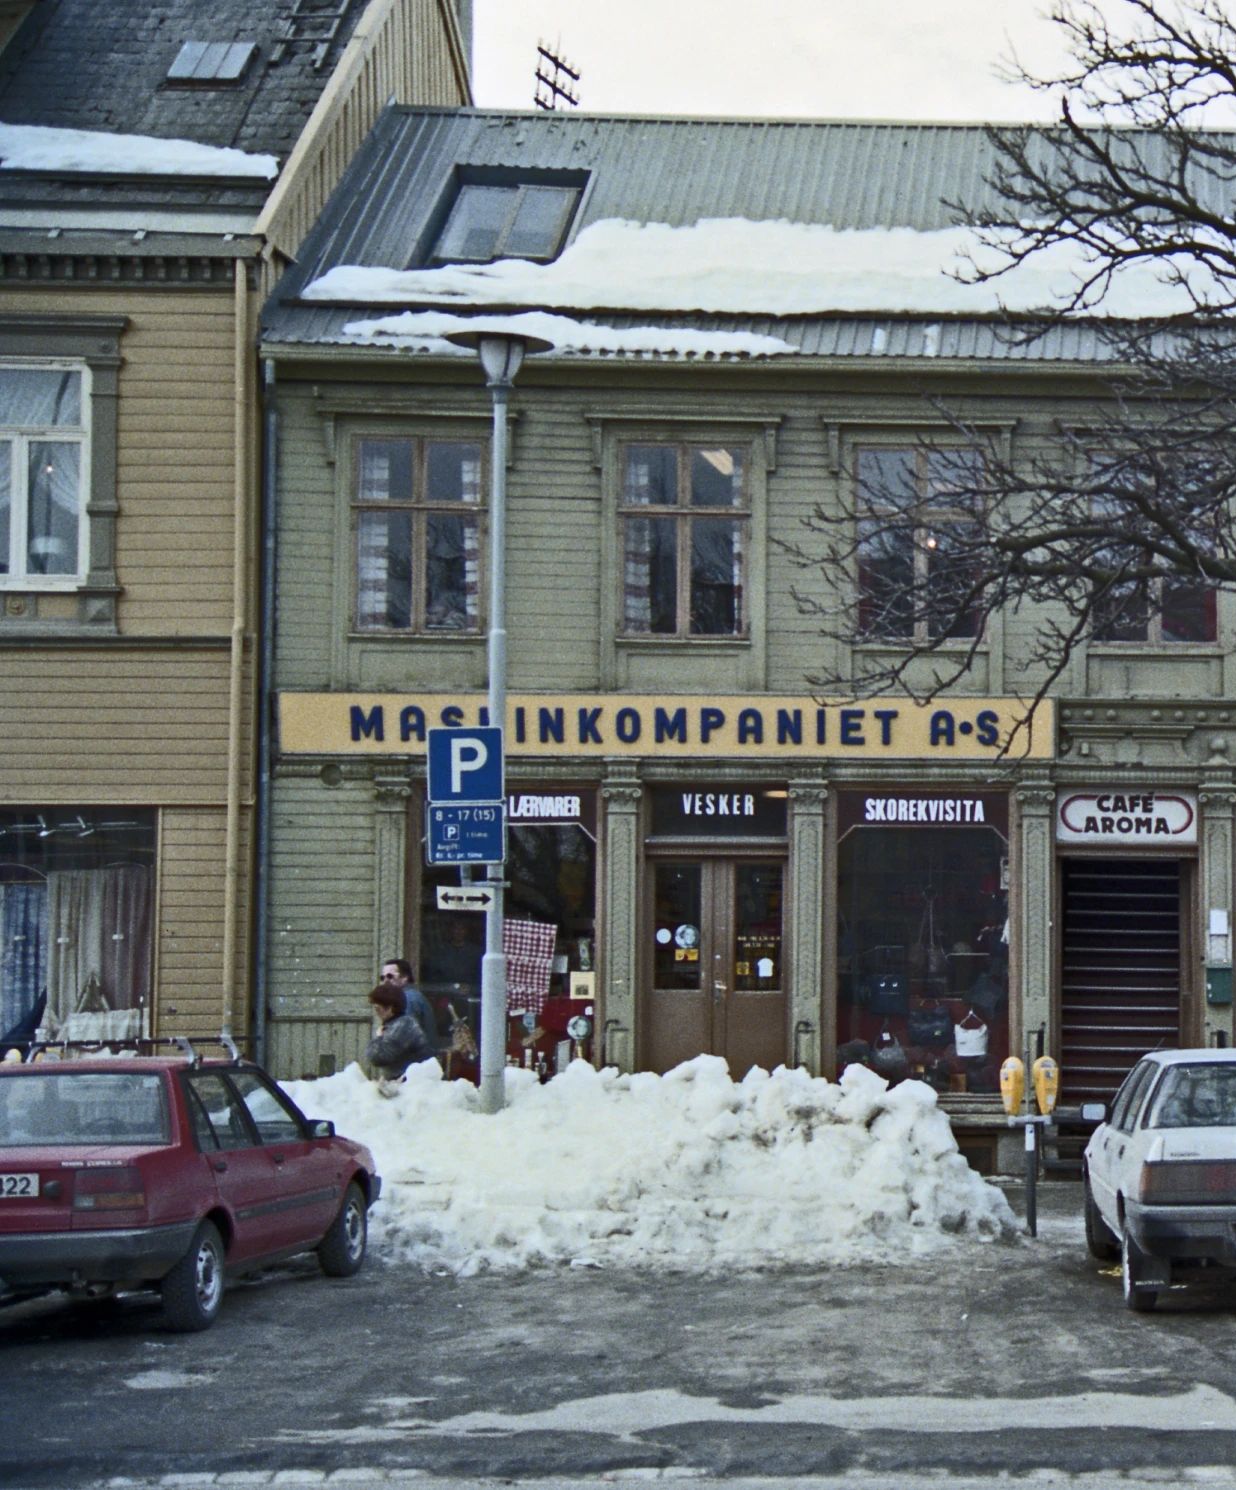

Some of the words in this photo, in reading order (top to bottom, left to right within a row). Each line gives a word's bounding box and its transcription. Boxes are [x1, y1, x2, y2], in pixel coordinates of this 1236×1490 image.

[350, 705, 898, 746] MASINKOMPANIET
[451, 738, 488, 793] P
[509, 795, 581, 817] LÆRVARER
[682, 793, 754, 816] VESKER
[865, 798, 985, 822] SKOREKVISITA
[1096, 791, 1155, 813] CAFÉ
[435, 810, 443, 821] 8
[457, 810, 470, 821] 17
[473, 808, 496, 822] (15)
[1084, 816, 1170, 834] AROMA
[0, 1176, 31, 1195] 22
